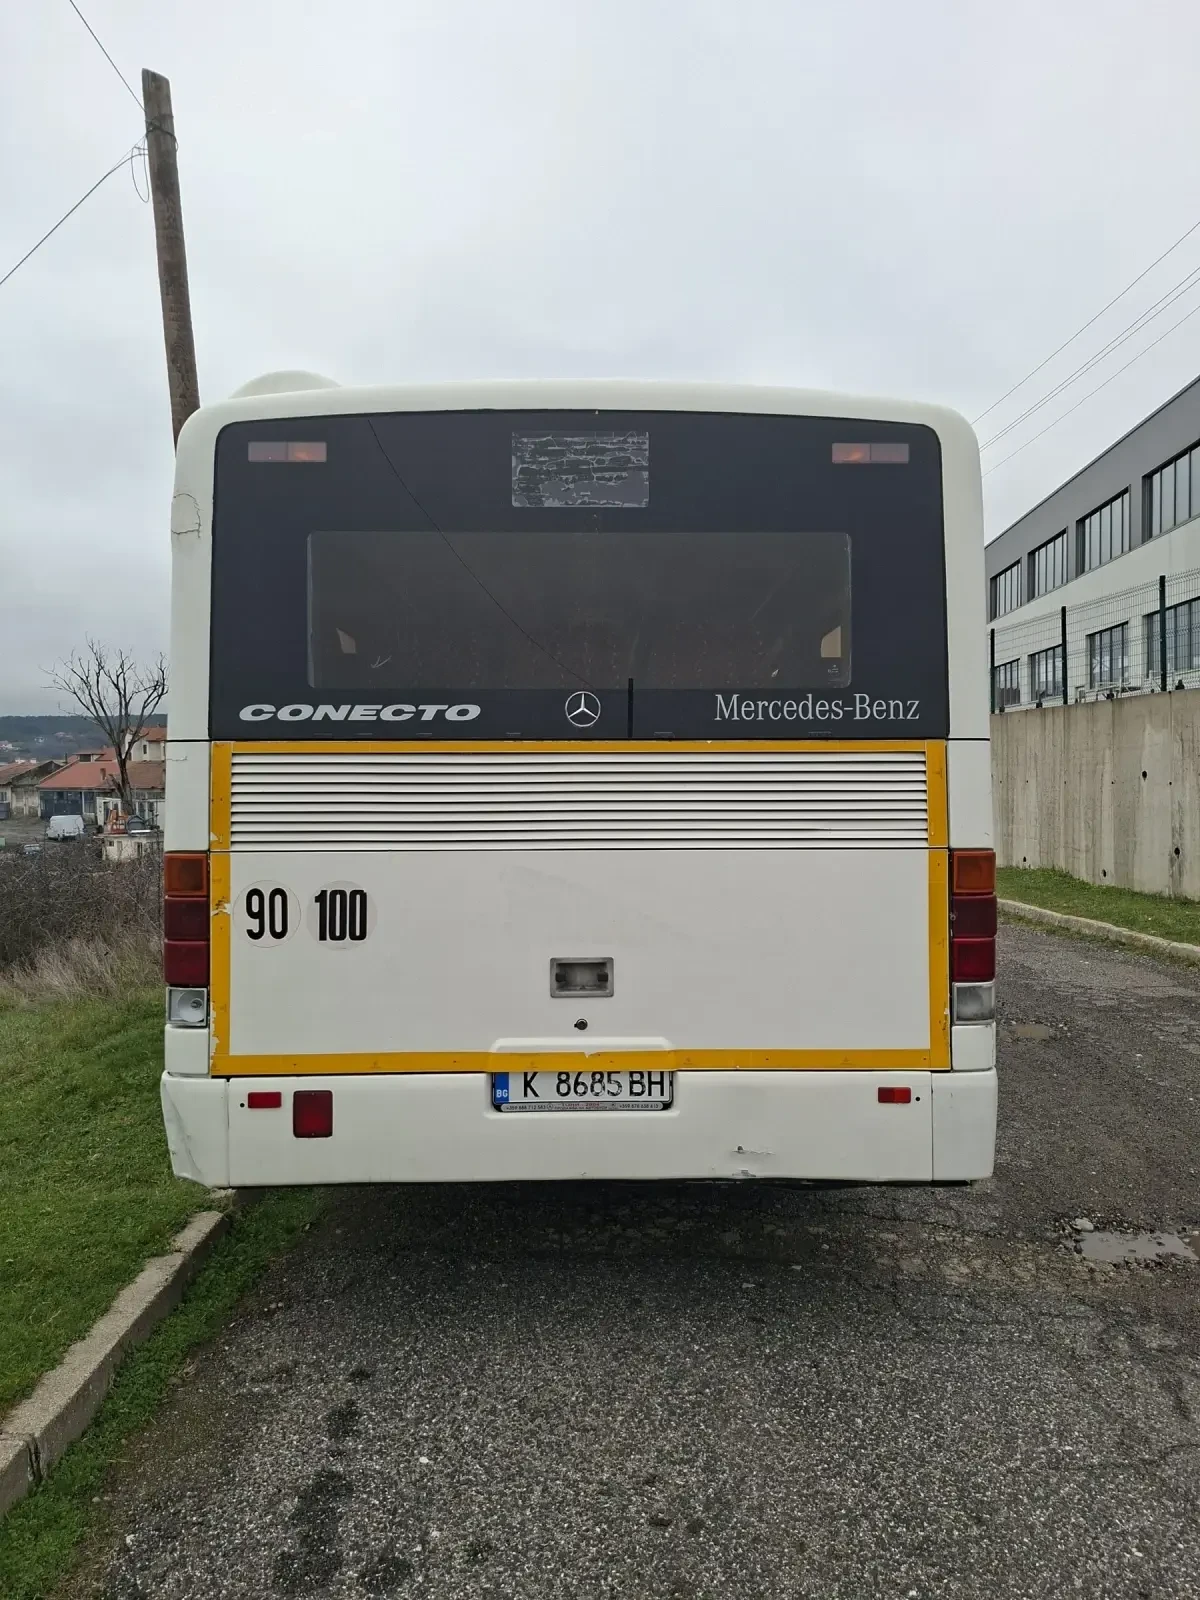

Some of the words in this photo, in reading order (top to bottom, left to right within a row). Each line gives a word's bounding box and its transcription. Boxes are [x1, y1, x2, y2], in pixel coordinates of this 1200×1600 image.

[239, 704, 481, 721] CONECTO
[714, 693, 920, 721] Mercedes-Benz
[245, 888, 289, 940] 90
[314, 889, 368, 941] 100
[496, 1089, 508, 1098] BG
[523, 1072, 540, 1098] K
[556, 1071, 623, 1097] 8685
[629, 1071, 665, 1097] BH
